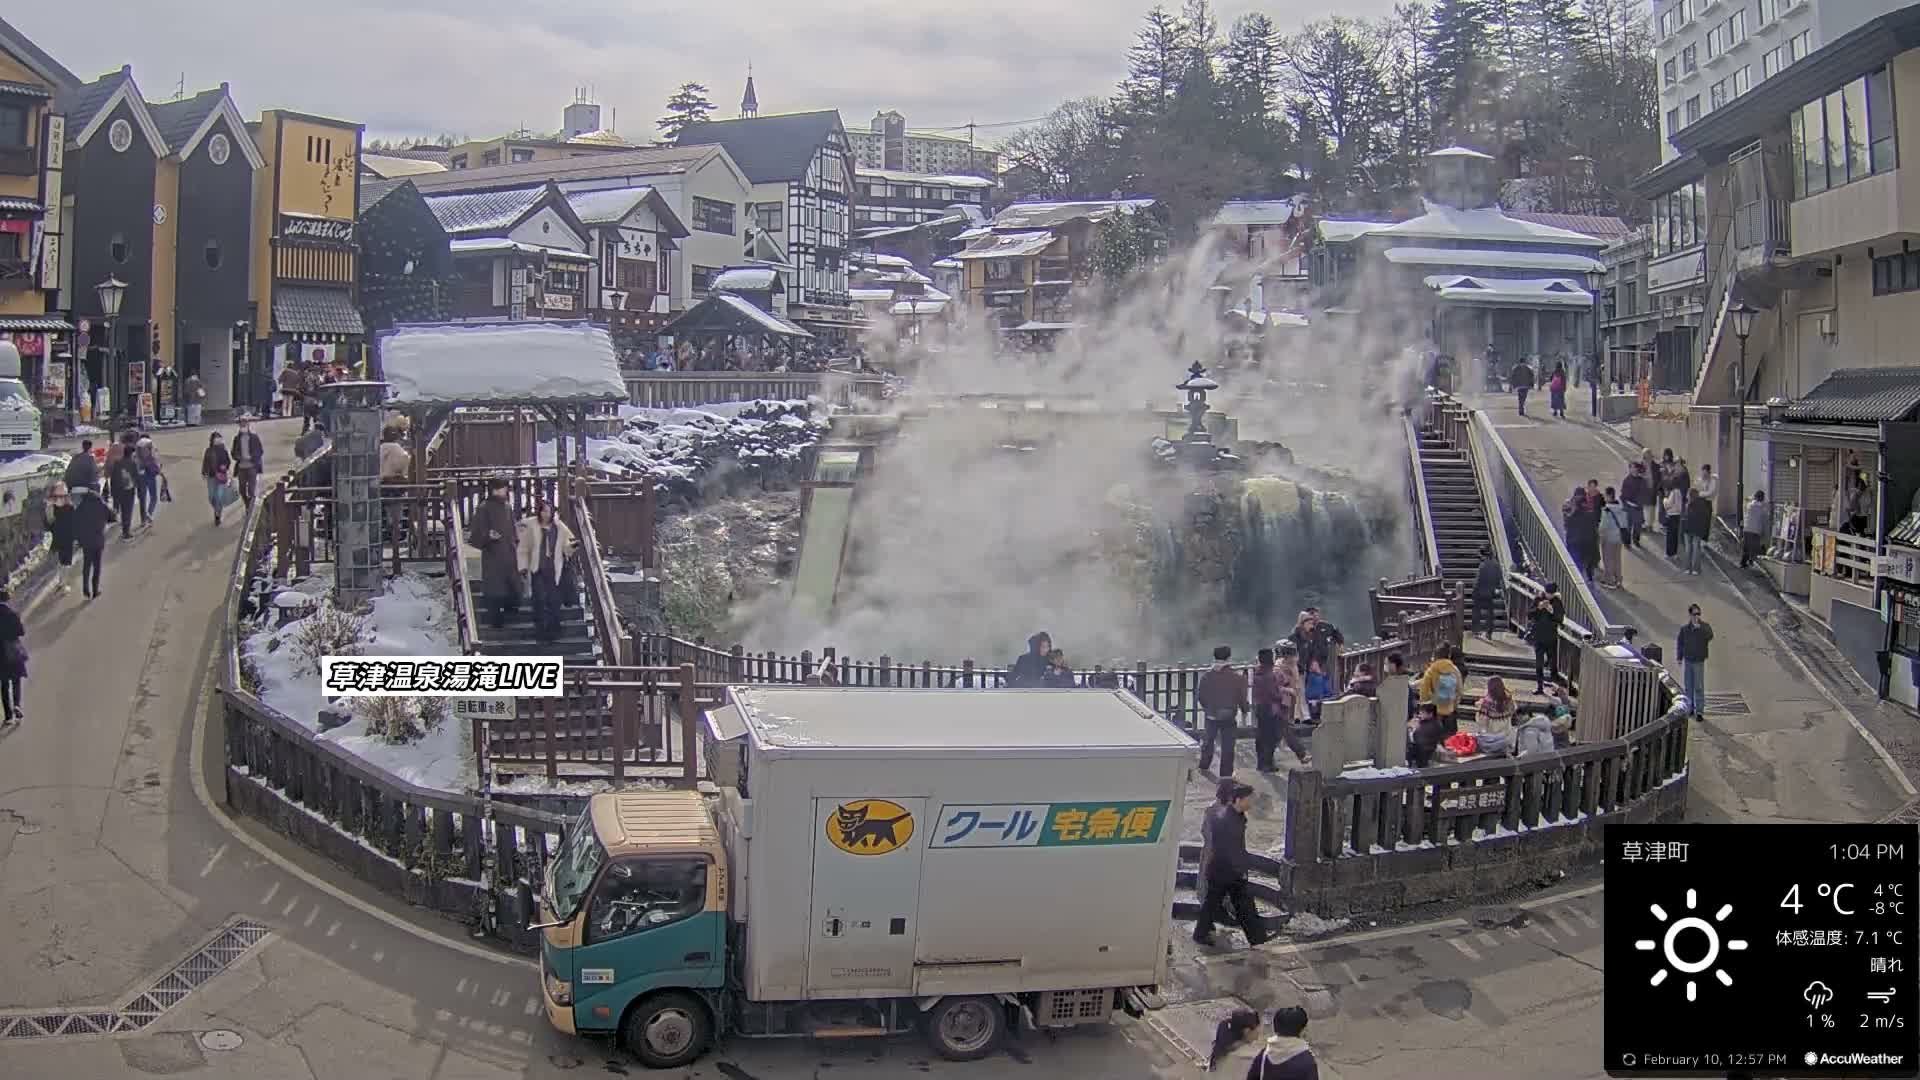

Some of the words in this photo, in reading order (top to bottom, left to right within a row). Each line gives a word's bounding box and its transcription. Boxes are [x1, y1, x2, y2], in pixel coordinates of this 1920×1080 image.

[623, 241, 652, 257] ちちや
[457, 700, 513, 715] 自転車を除く
[944, 810, 1038, 843] クール
[1052, 806, 1159, 841] 宅急便
